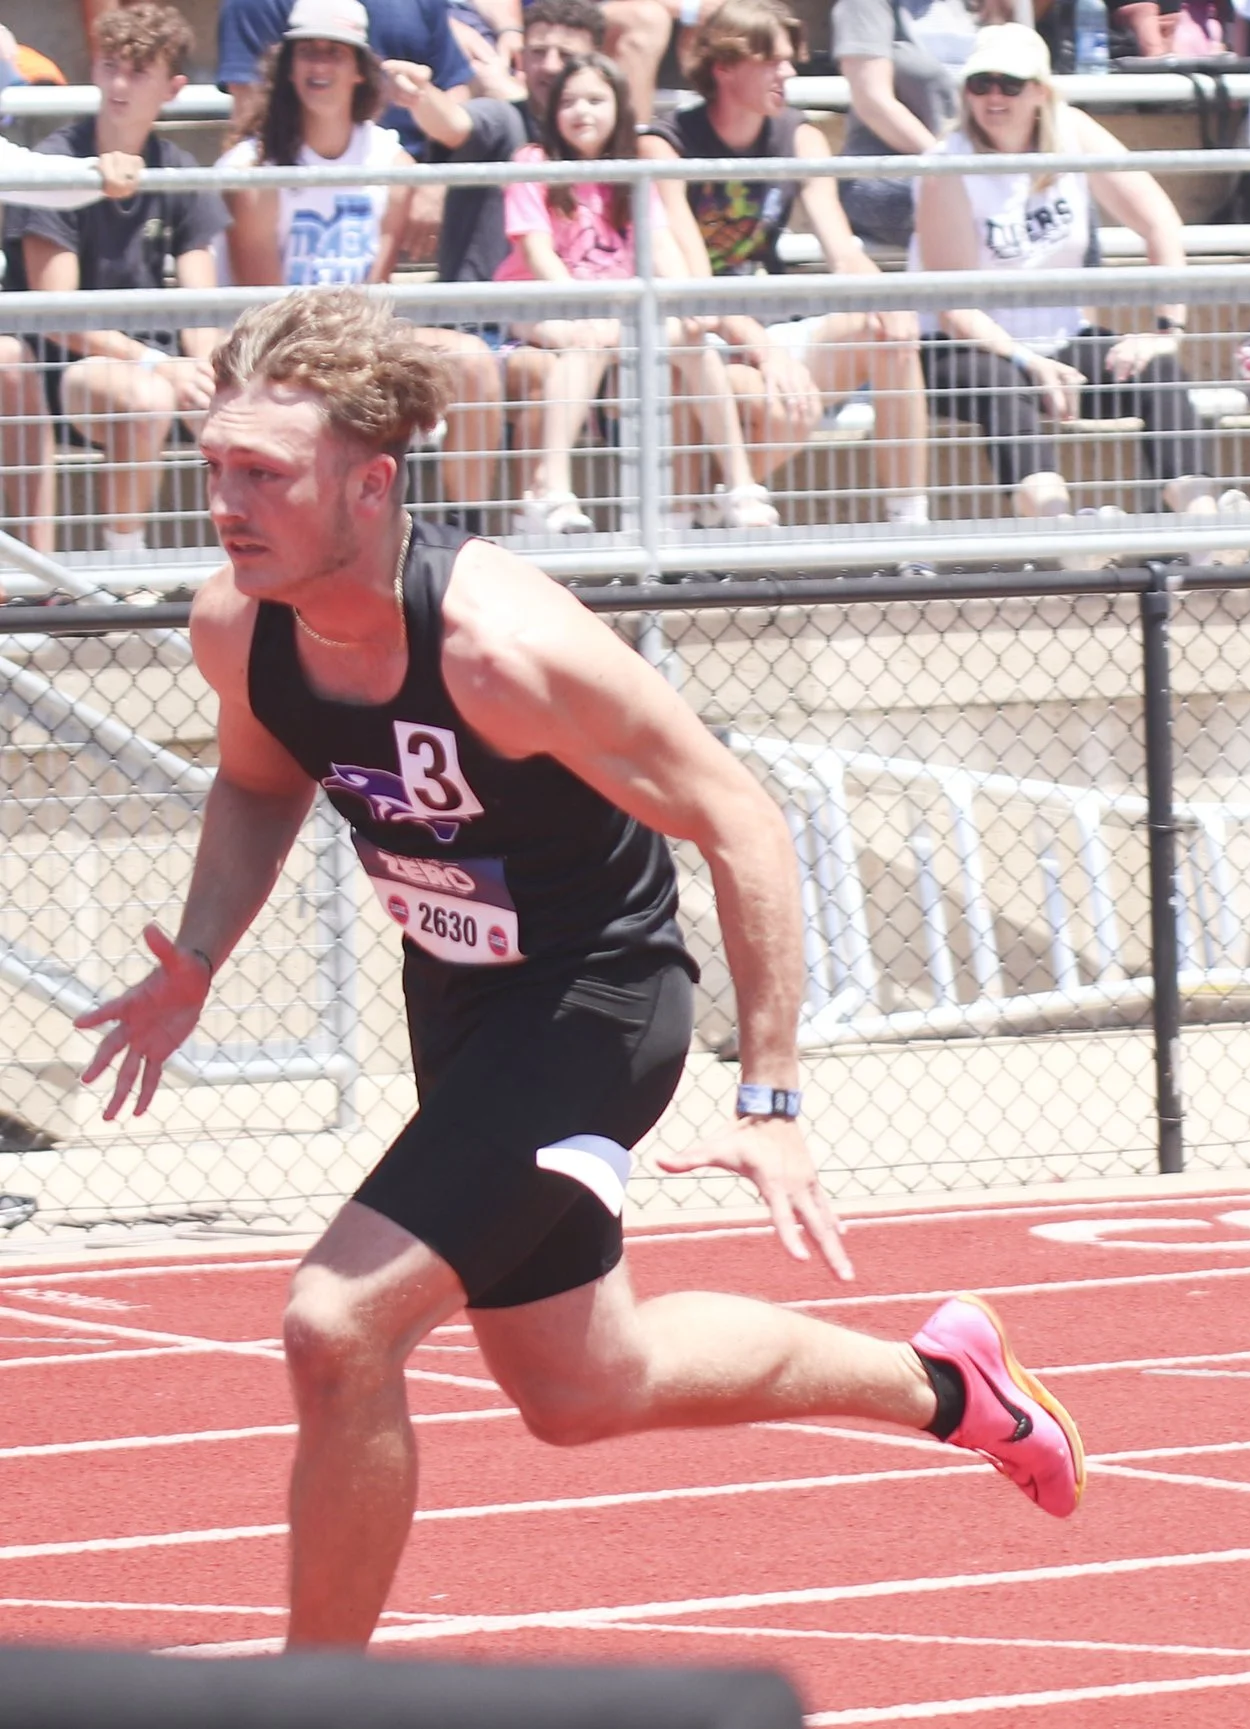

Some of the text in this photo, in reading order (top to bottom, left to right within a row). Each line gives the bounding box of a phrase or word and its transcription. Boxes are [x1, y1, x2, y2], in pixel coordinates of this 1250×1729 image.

[407, 730, 464, 811] 3
[377, 849, 476, 893] ZERO
[418, 901, 478, 947] 2630
